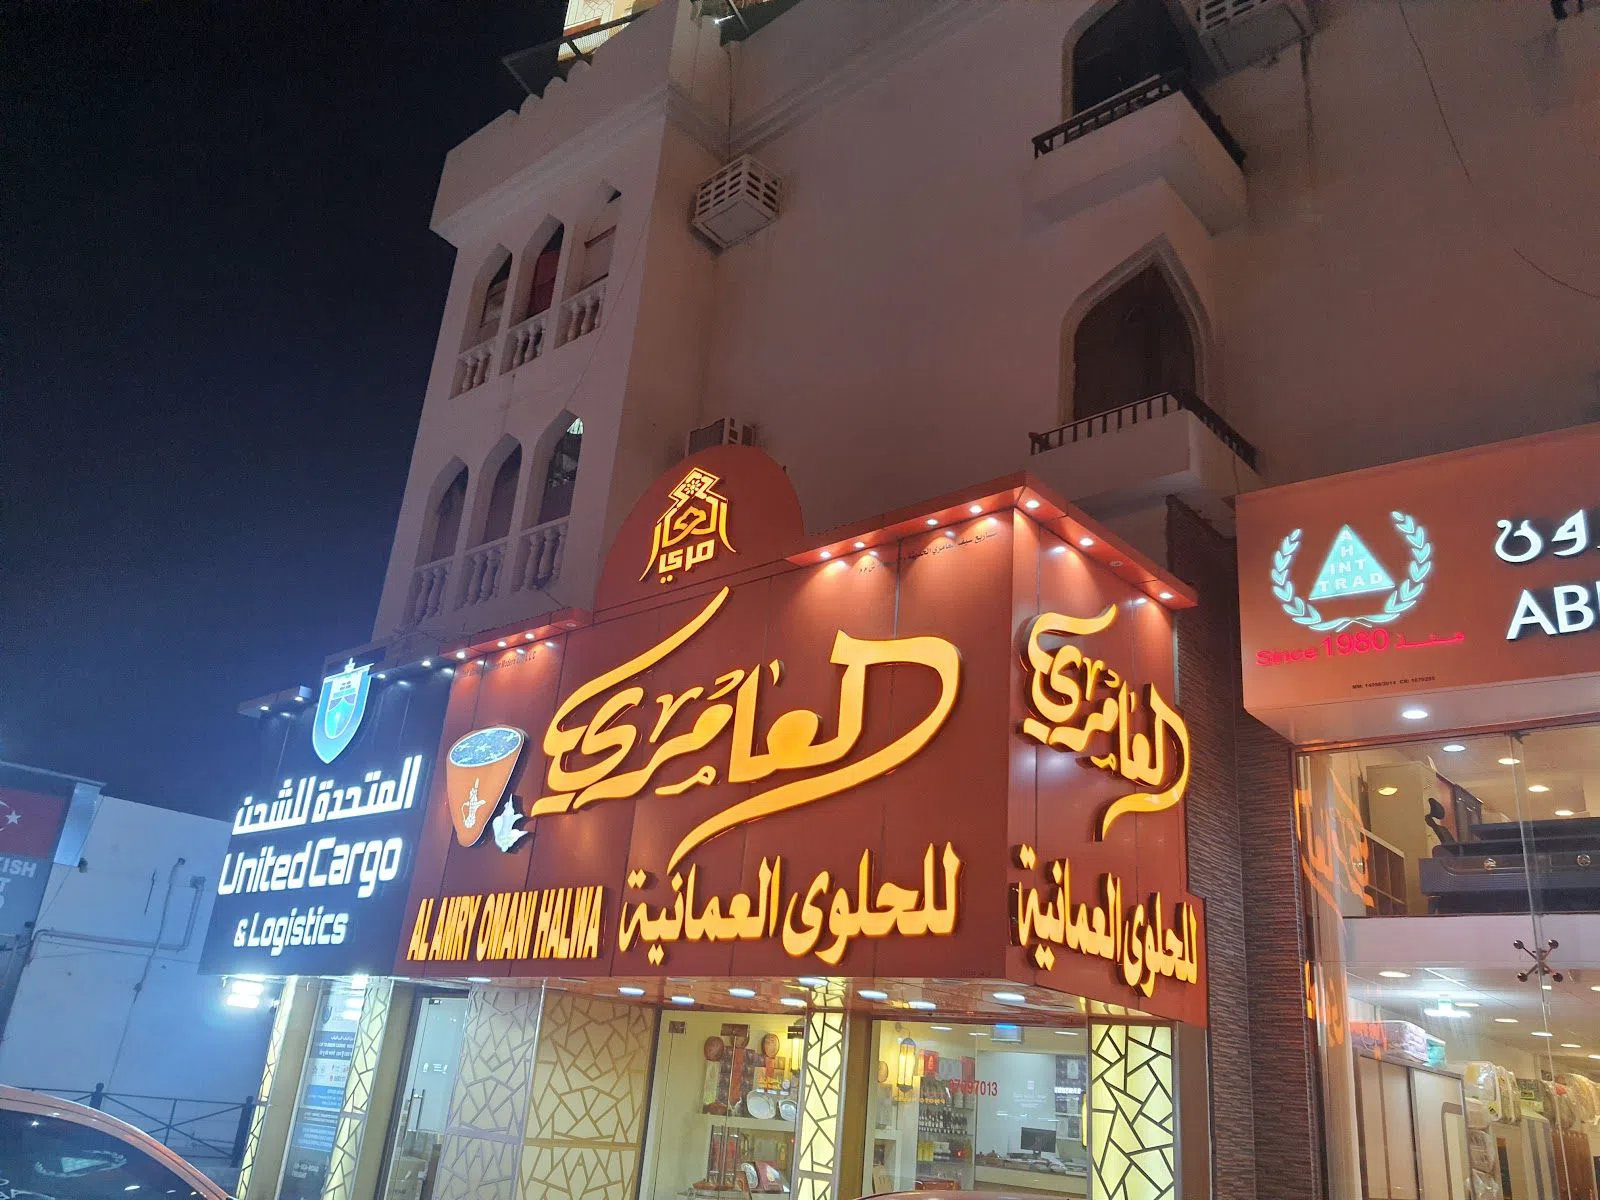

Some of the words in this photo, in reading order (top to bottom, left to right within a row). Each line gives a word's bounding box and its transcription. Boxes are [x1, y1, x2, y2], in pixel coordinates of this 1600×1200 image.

[1318, 571, 1383, 593] TRAD
[1329, 557, 1367, 575] INT
[1340, 544, 1354, 558] H
[1506, 581, 1600, 640] AB
[1255, 646, 1317, 667] Since
[1321, 627, 1390, 658] 1980
[231, 775, 317, 836] للشحن
[311, 754, 423, 824] المتحدة
[217, 840, 314, 896] United
[308, 836, 403, 899] Cargo
[233, 917, 248, 947] &
[247, 905, 350, 957] Logistics
[406, 898, 435, 961] AL
[428, 895, 483, 961] AMRY
[476, 890, 539, 962] OMANI
[532, 885, 604, 960] HALWA
[618, 854, 781, 966] العمانية
[782, 840, 962, 965] للحلوى
[1016, 843, 1123, 971] العمانية
[1122, 891, 1198, 999] للحلوى
